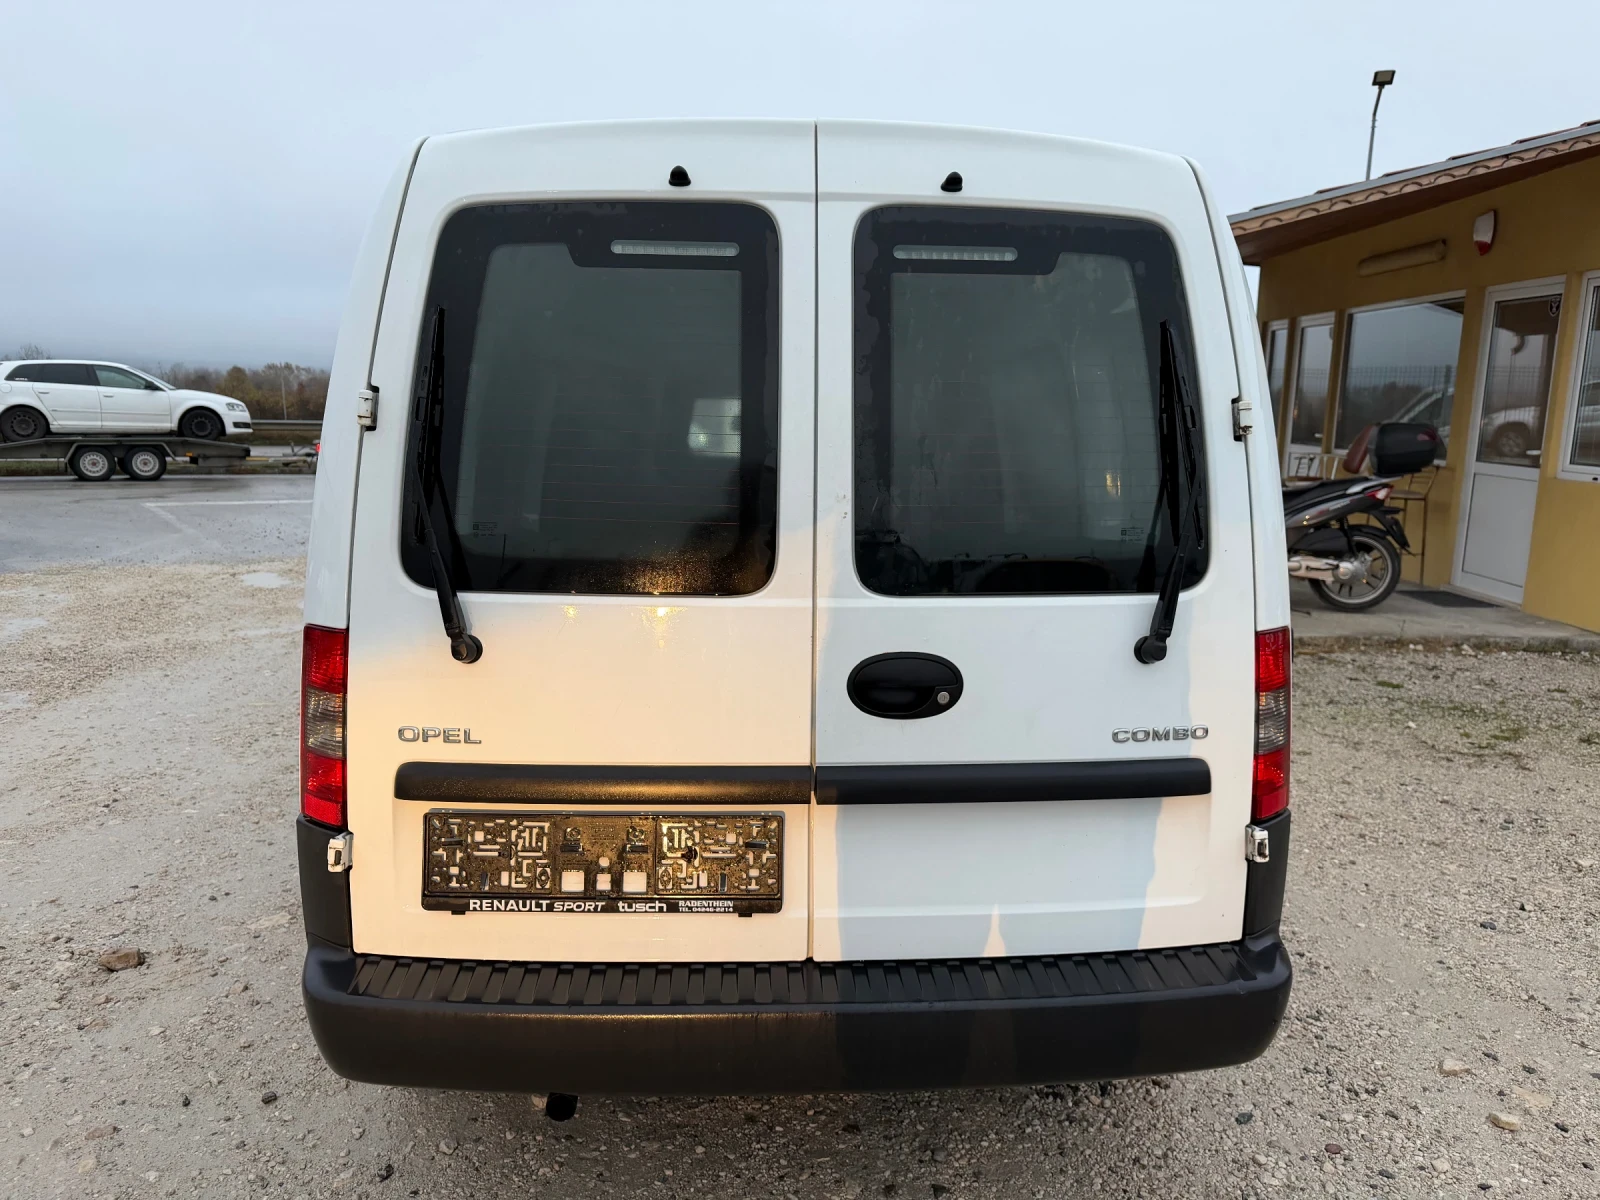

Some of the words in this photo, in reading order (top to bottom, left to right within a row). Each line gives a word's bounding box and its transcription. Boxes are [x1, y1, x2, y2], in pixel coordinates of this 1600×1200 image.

[398, 726, 482, 744] OPEL
[1112, 725, 1209, 744] COMBO
[469, 899, 550, 912] RENAULT
[553, 901, 605, 912] SPORT
[617, 900, 667, 912] tusch
